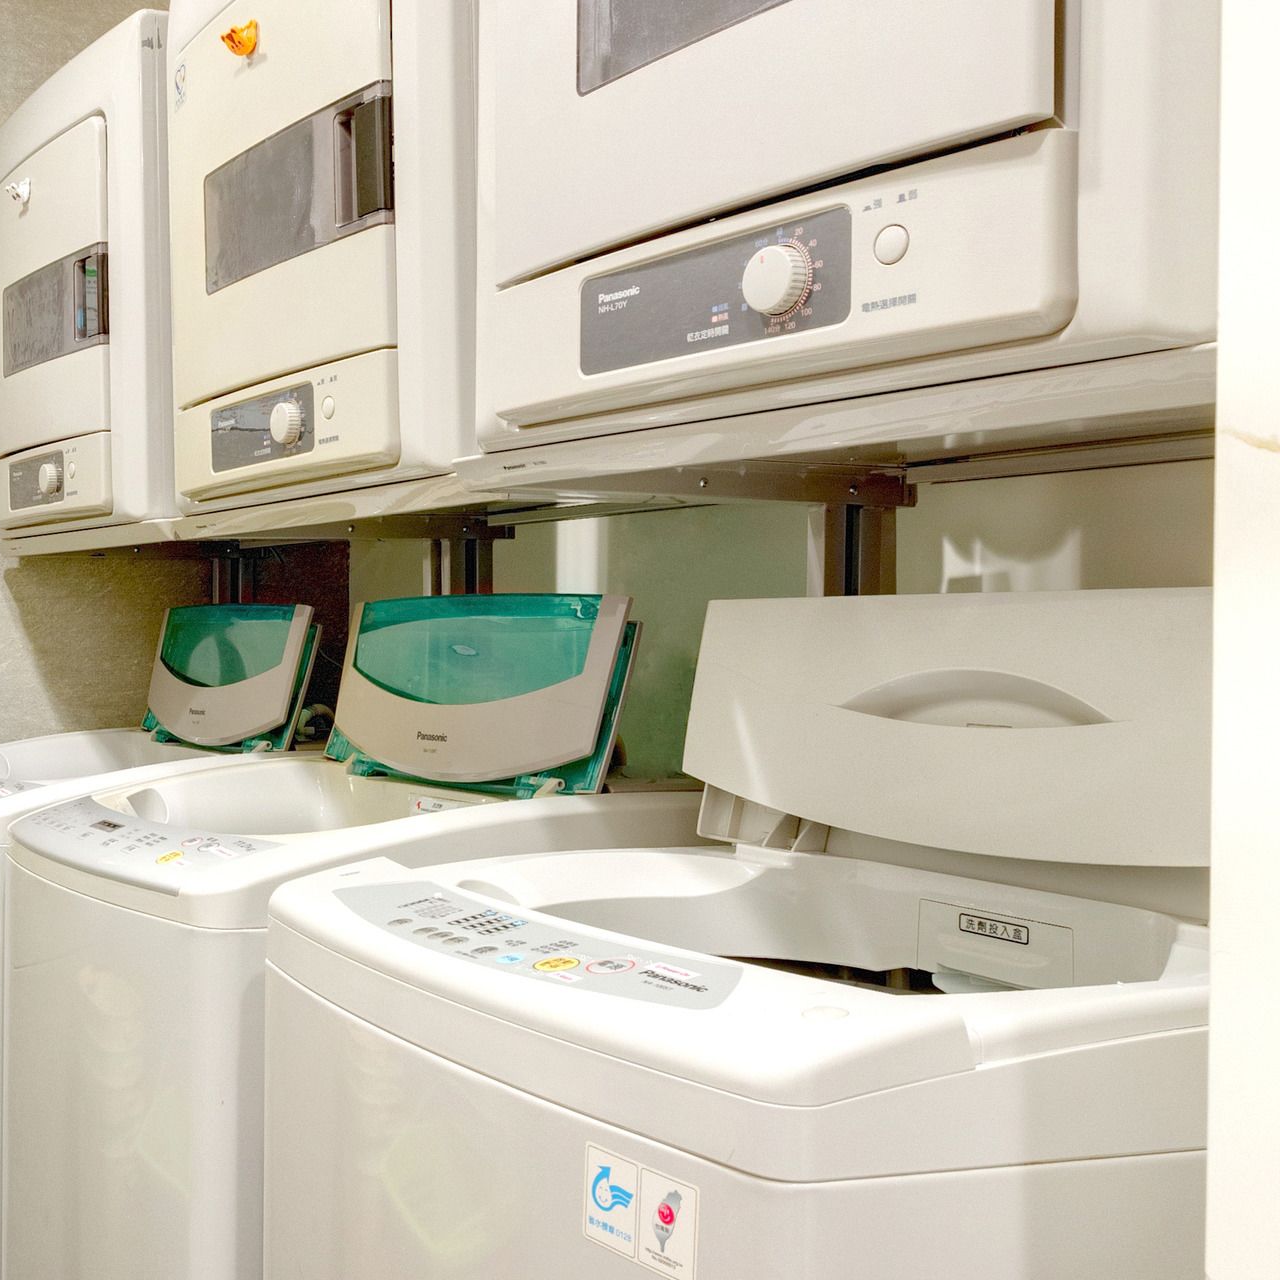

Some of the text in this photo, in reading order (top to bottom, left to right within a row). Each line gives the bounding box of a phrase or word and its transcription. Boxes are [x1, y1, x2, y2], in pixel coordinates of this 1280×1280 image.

[794, 227, 803, 236] 20
[808, 238, 817, 247] 40
[815, 260, 824, 268] 60
[813, 283, 822, 291] 80
[598, 285, 640, 304] Panasonic
[598, 300, 628, 314] NH-L70Y
[800, 308, 813, 316] 100
[784, 322, 796, 330] 120
[416, 731, 448, 742] Panasonic
[965, 918, 1023, 941] 洗劑投入盒
[638, 969, 709, 993] Panasonic
